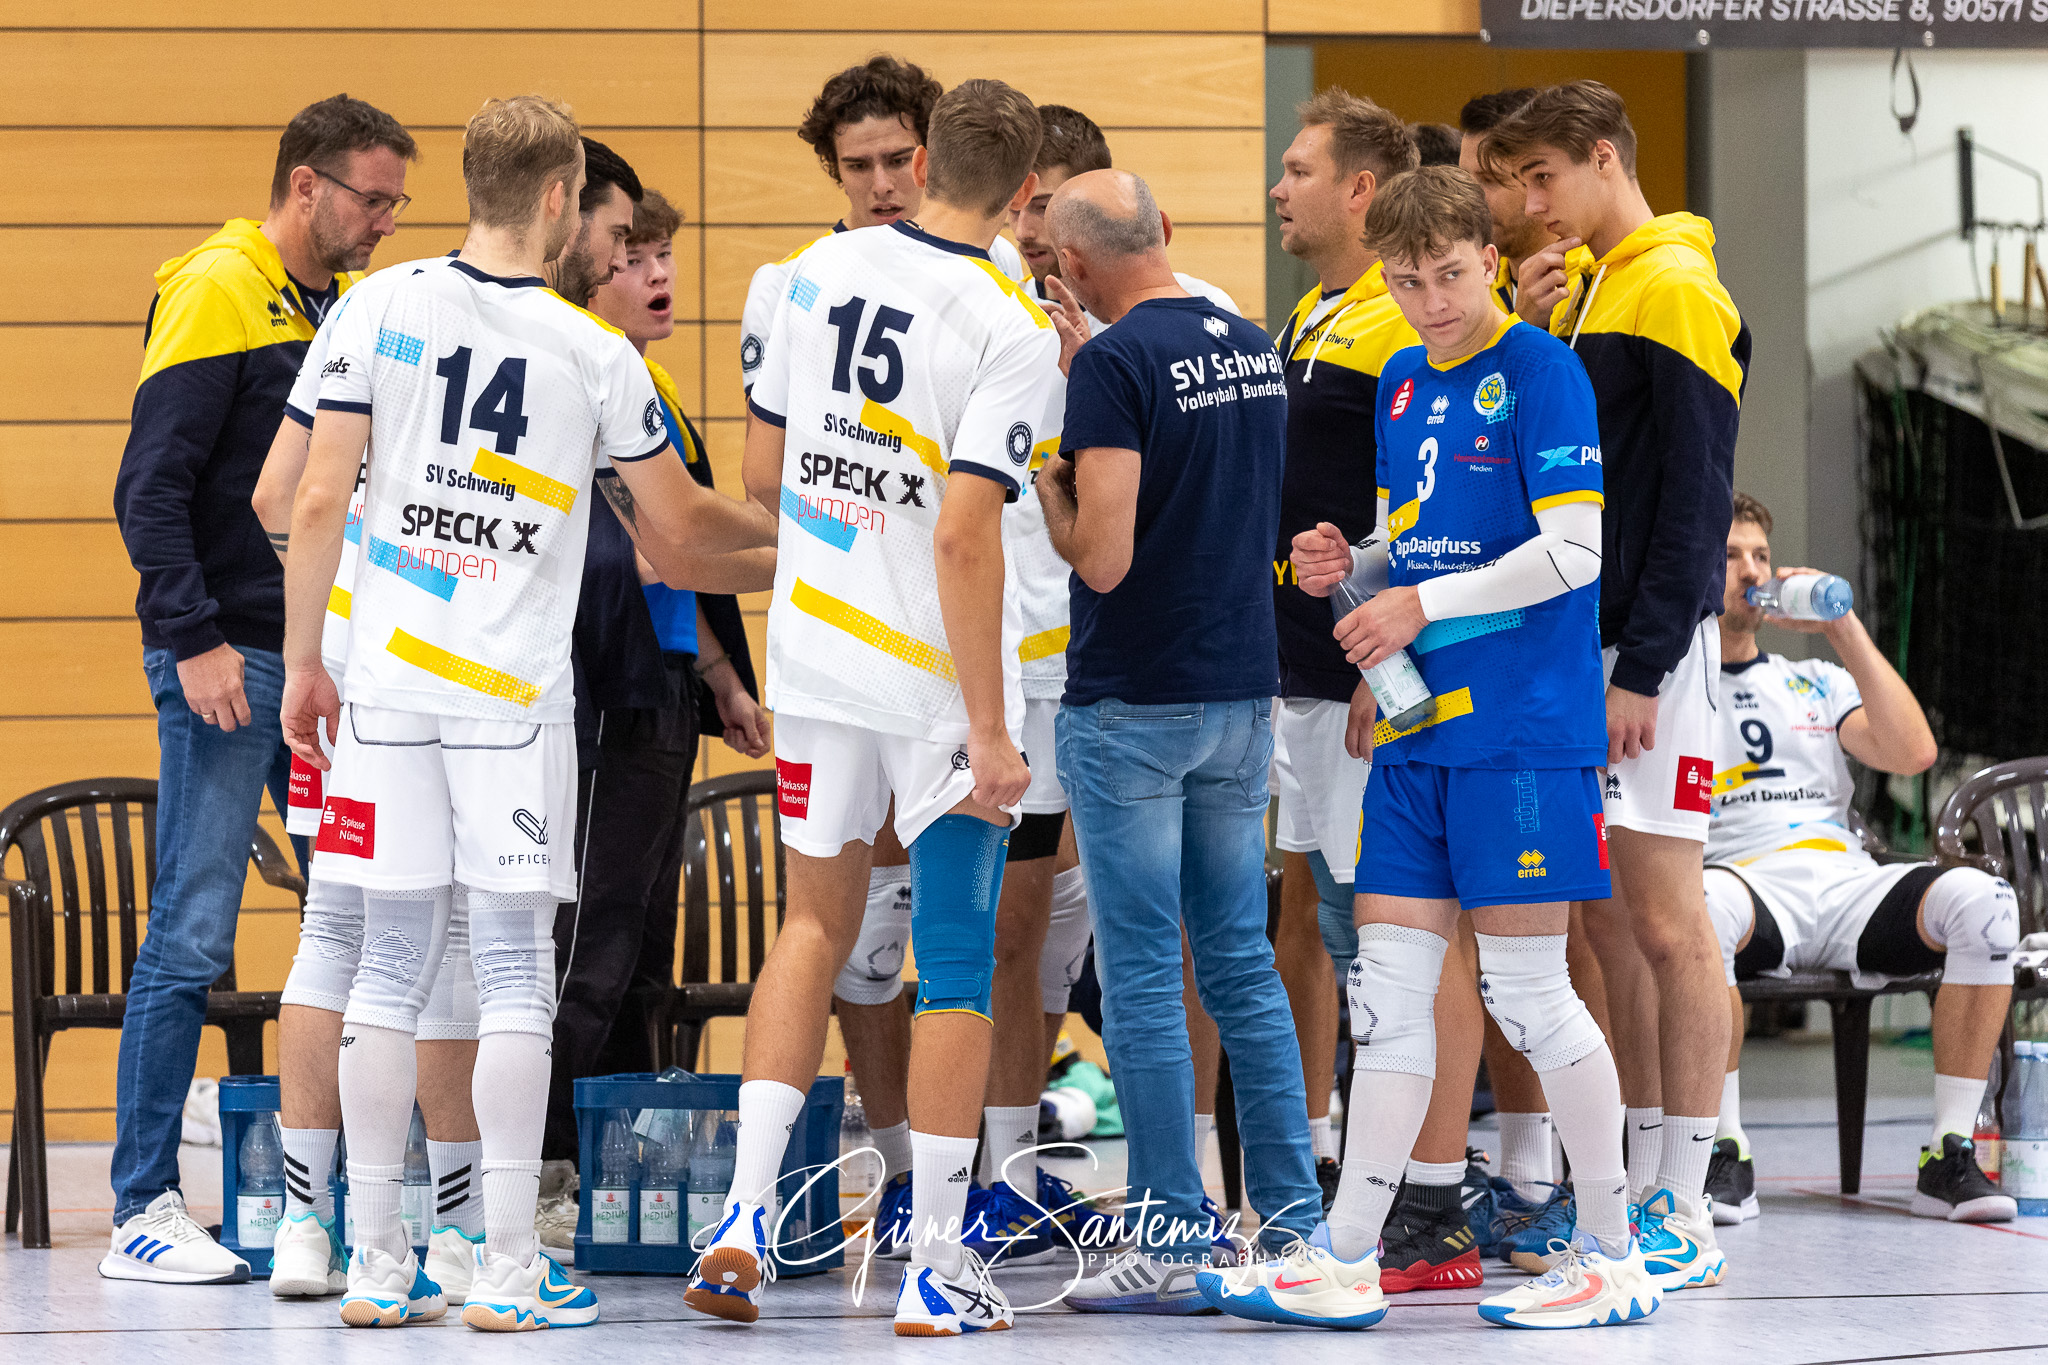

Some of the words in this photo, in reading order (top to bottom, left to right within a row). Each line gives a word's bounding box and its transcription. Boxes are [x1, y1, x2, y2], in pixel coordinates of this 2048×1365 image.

[1520, 0, 1762, 21] DIEPERSDORFER
[1769, 0, 1900, 21] STRASSE
[1942, 0, 2023, 22] 90571
[828, 295, 915, 404] 15
[1170, 355, 1206, 392] SV
[1210, 346, 1285, 381] Schwai
[436, 345, 529, 456] 14
[1176, 385, 1238, 413] Volleyball
[839, 417, 902, 454] Schwaig
[1427, 414, 1446, 425] errea
[1416, 436, 1439, 503] 3
[1469, 464, 1493, 473] Medien
[1580, 445, 1603, 466] pul
[426, 463, 444, 484] SV
[446, 468, 516, 502] Schwaig
[800, 451, 890, 502] SPECK
[400, 503, 503, 550] SPECK
[797, 493, 885, 535] pumpen
[396, 545, 497, 582] pumpen
[1739, 718, 1774, 765] 9
[782, 778, 808, 791] Sparkasse
[1517, 867, 1547, 879] errea
[595, 1210, 629, 1222] MEDIUM
[644, 1210, 678, 1222] MEDIUM
